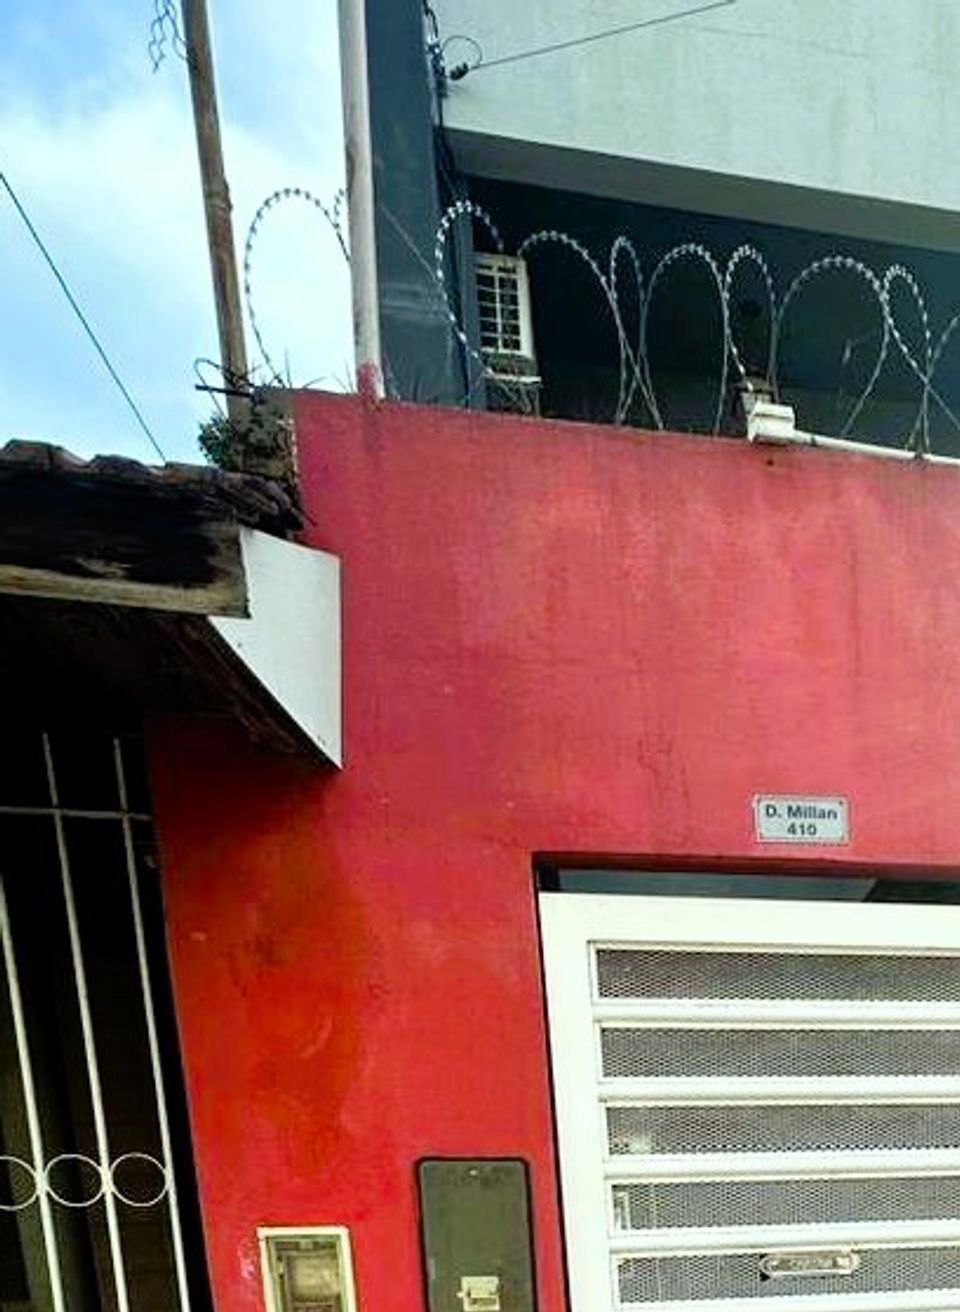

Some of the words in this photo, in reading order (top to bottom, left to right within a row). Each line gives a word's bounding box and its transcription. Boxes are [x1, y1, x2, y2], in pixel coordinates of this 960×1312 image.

[765, 804, 782, 818] D.
[787, 805, 838, 819] Millan
[787, 822, 817, 836] 410
